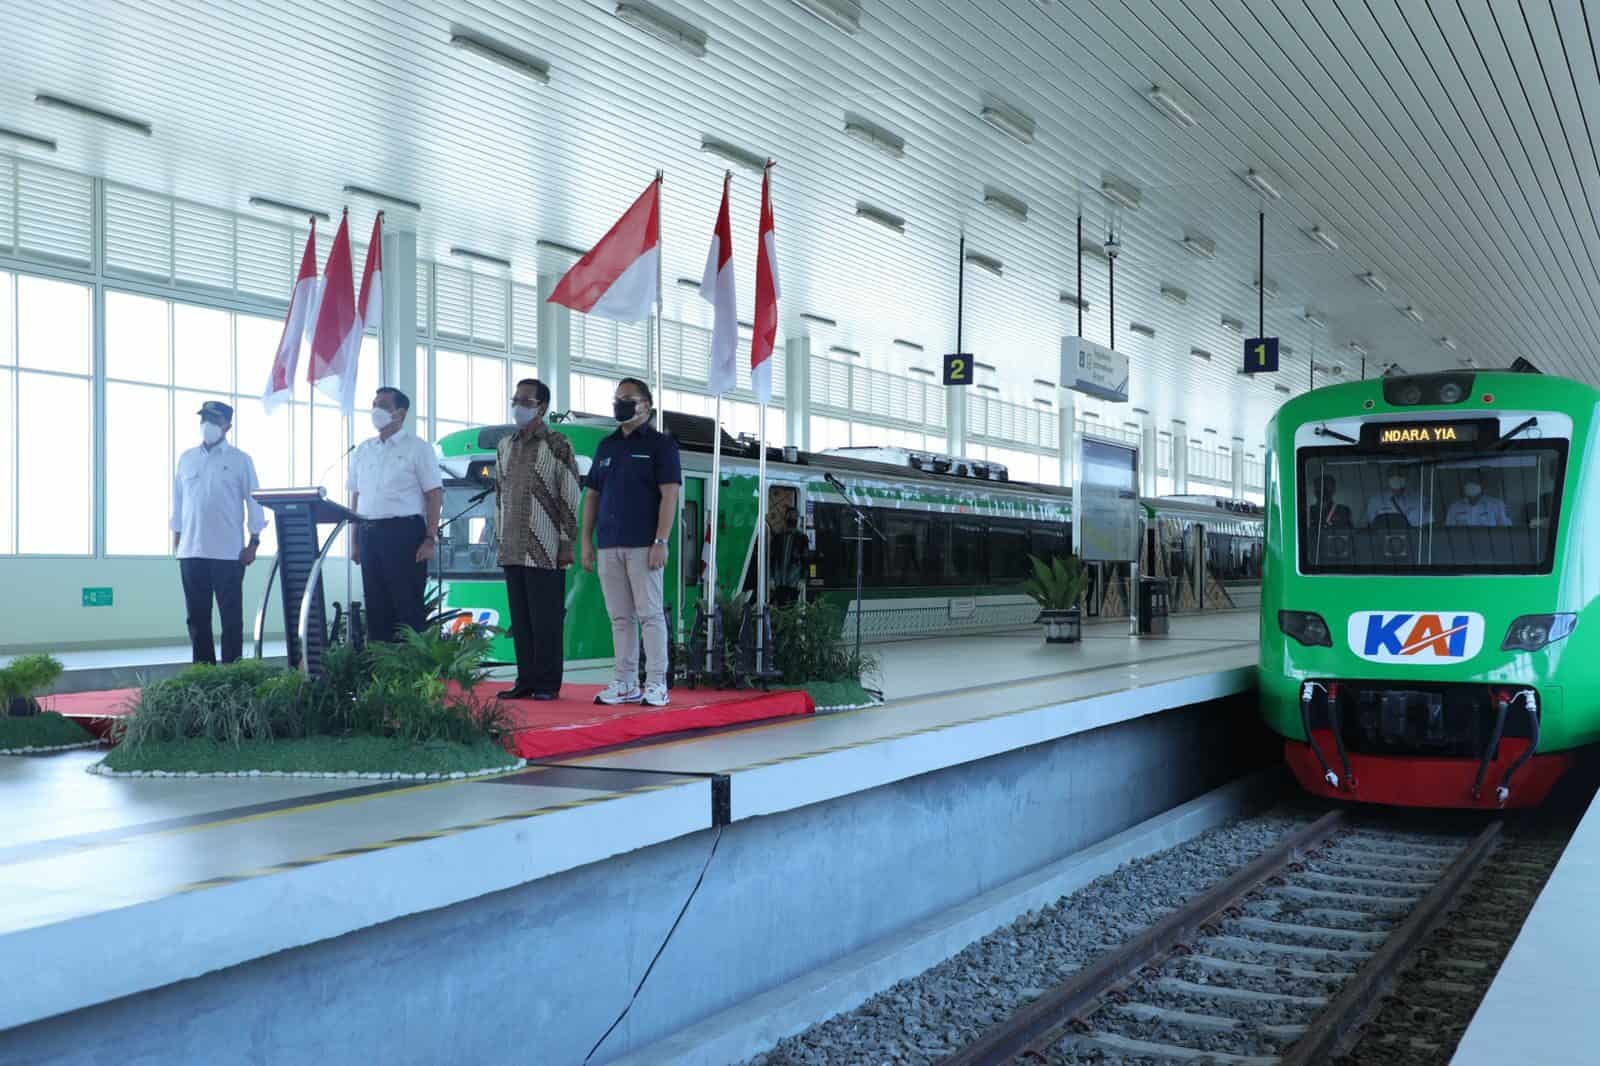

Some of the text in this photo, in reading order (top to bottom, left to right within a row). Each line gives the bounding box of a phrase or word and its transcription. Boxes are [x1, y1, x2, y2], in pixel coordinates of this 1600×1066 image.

[1254, 344, 1265, 366] 1
[951, 359, 965, 379] 2
[1382, 427, 1457, 442] NDARA YIA
[1364, 614, 1469, 657] KAI
